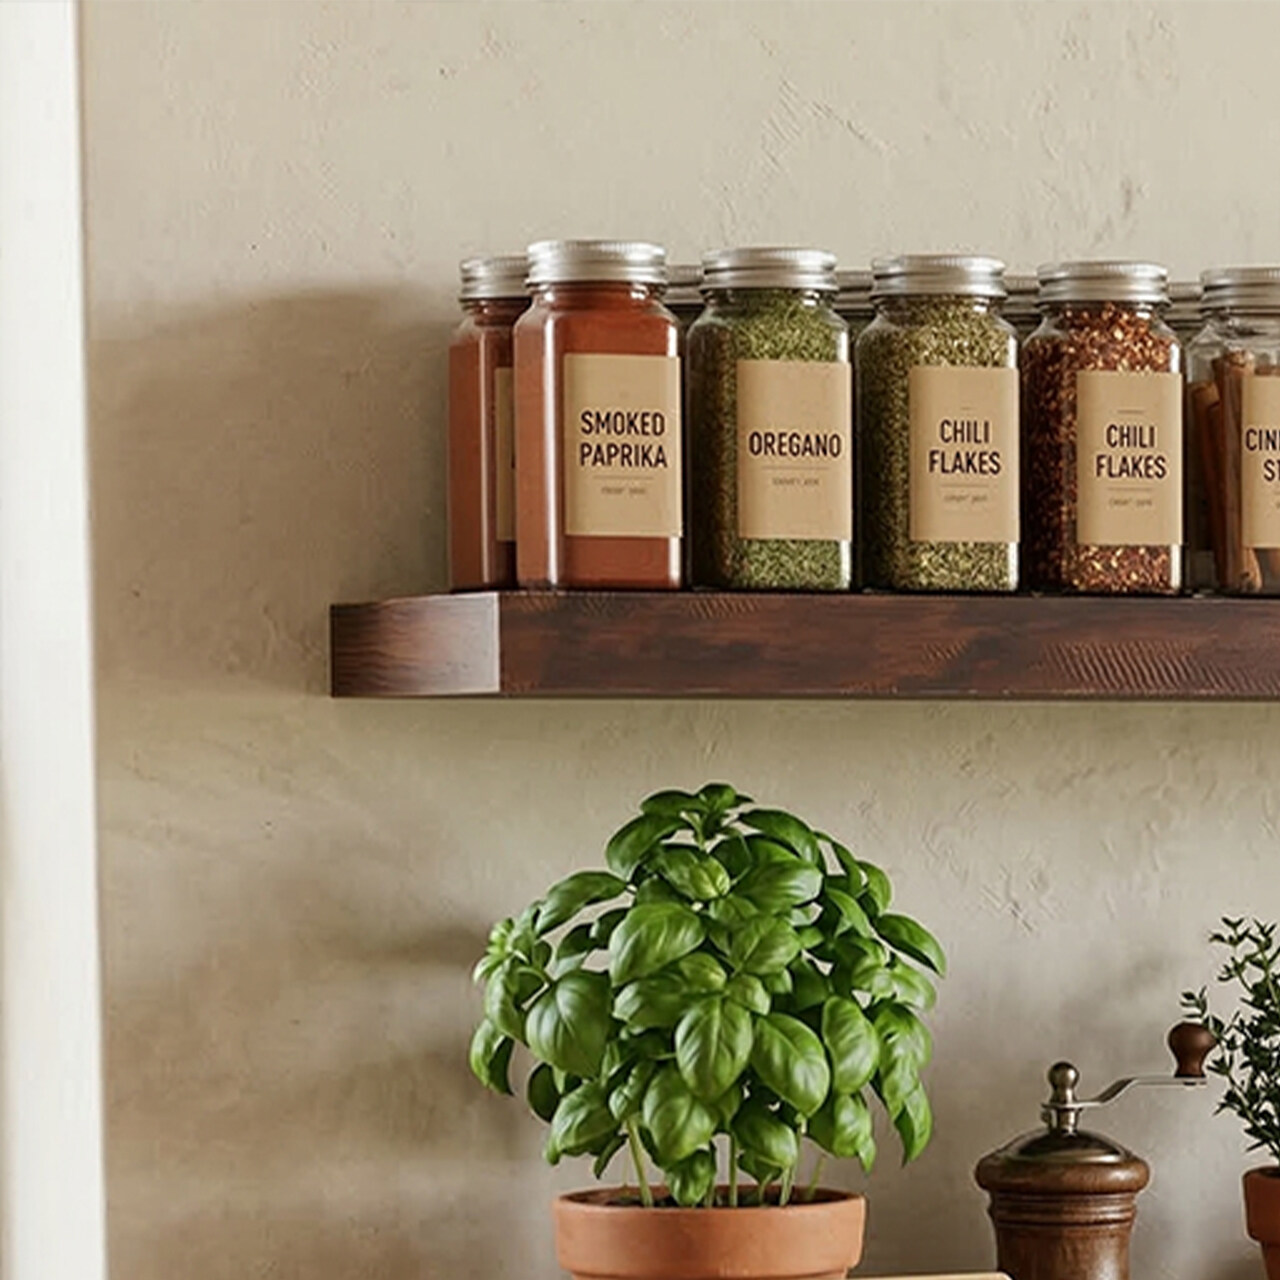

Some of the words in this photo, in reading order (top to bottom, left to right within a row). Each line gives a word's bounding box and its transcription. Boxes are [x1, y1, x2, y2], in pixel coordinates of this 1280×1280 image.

[580, 410, 665, 436] SMOKED
[939, 419, 990, 443] CHILI
[749, 431, 842, 457] OREGANO
[1105, 424, 1156, 448] CHILI
[579, 442, 668, 468] PAPRIKA
[928, 450, 1002, 475] FLAKES
[1095, 454, 1167, 479] FLAKES
